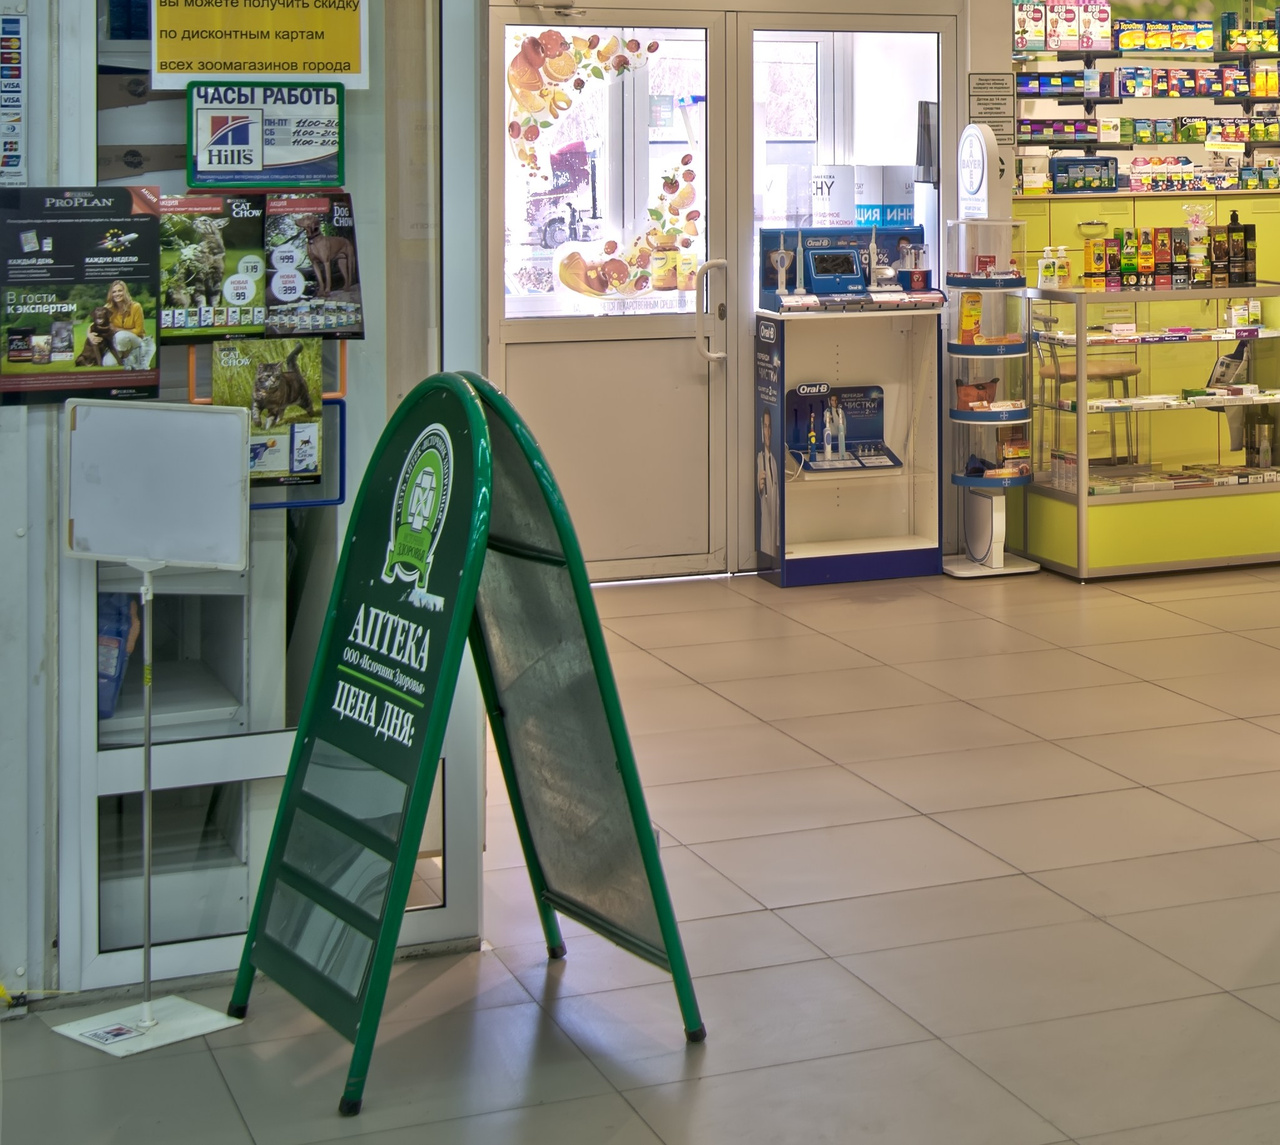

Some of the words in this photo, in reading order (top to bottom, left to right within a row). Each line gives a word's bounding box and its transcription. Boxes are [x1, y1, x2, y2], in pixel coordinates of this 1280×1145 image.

[313, 0, 360, 11] скидку
[159, 30, 177, 39] по
[182, 30, 270, 41] дисконтным
[274, 31, 325, 42] картам
[160, 61, 193, 71] всех
[197, 61, 298, 71] зоомагазинов
[302, 61, 351, 73] города
[196, 87, 255, 104] ЧАСЫ
[961, 159, 982, 169] BAYER
[140, 188, 158, 203] АКЦИЯ
[232, 202, 251, 210] CAT
[232, 209, 262, 218] CHOW
[334, 207, 350, 216] DOG
[806, 239, 829, 247] Oral-B
[7, 292, 16, 304] В
[21, 294, 56, 303] гости
[18, 304, 77, 314] экспертам
[760, 325, 775, 339] Oral-B
[221, 351, 240, 359] CAT
[221, 358, 251, 367] CHOW
[800, 384, 827, 394] Oral-B
[844, 401, 877, 409] ЧИСТКИ
[348, 602, 430, 672] АПТЕКА
[343, 646, 360, 666] ООО
[333, 679, 378, 728] ЦЕНА
